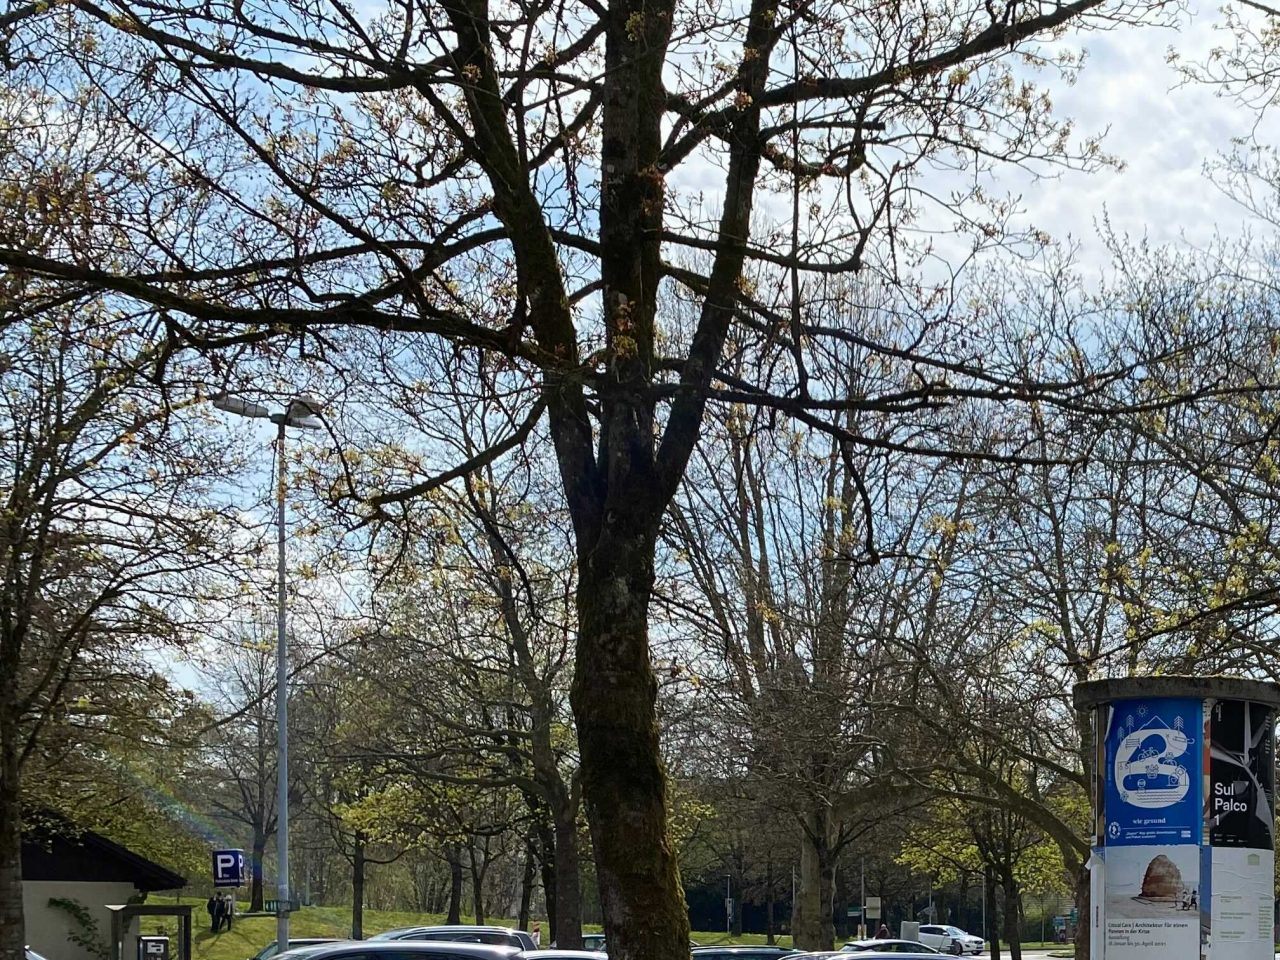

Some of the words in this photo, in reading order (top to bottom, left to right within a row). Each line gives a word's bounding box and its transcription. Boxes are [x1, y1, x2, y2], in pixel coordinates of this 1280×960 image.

[1214, 782, 1235, 796] Sul
[1214, 798, 1248, 812] Palco
[1214, 814, 1220, 826] 1
[217, 855, 235, 878] P
